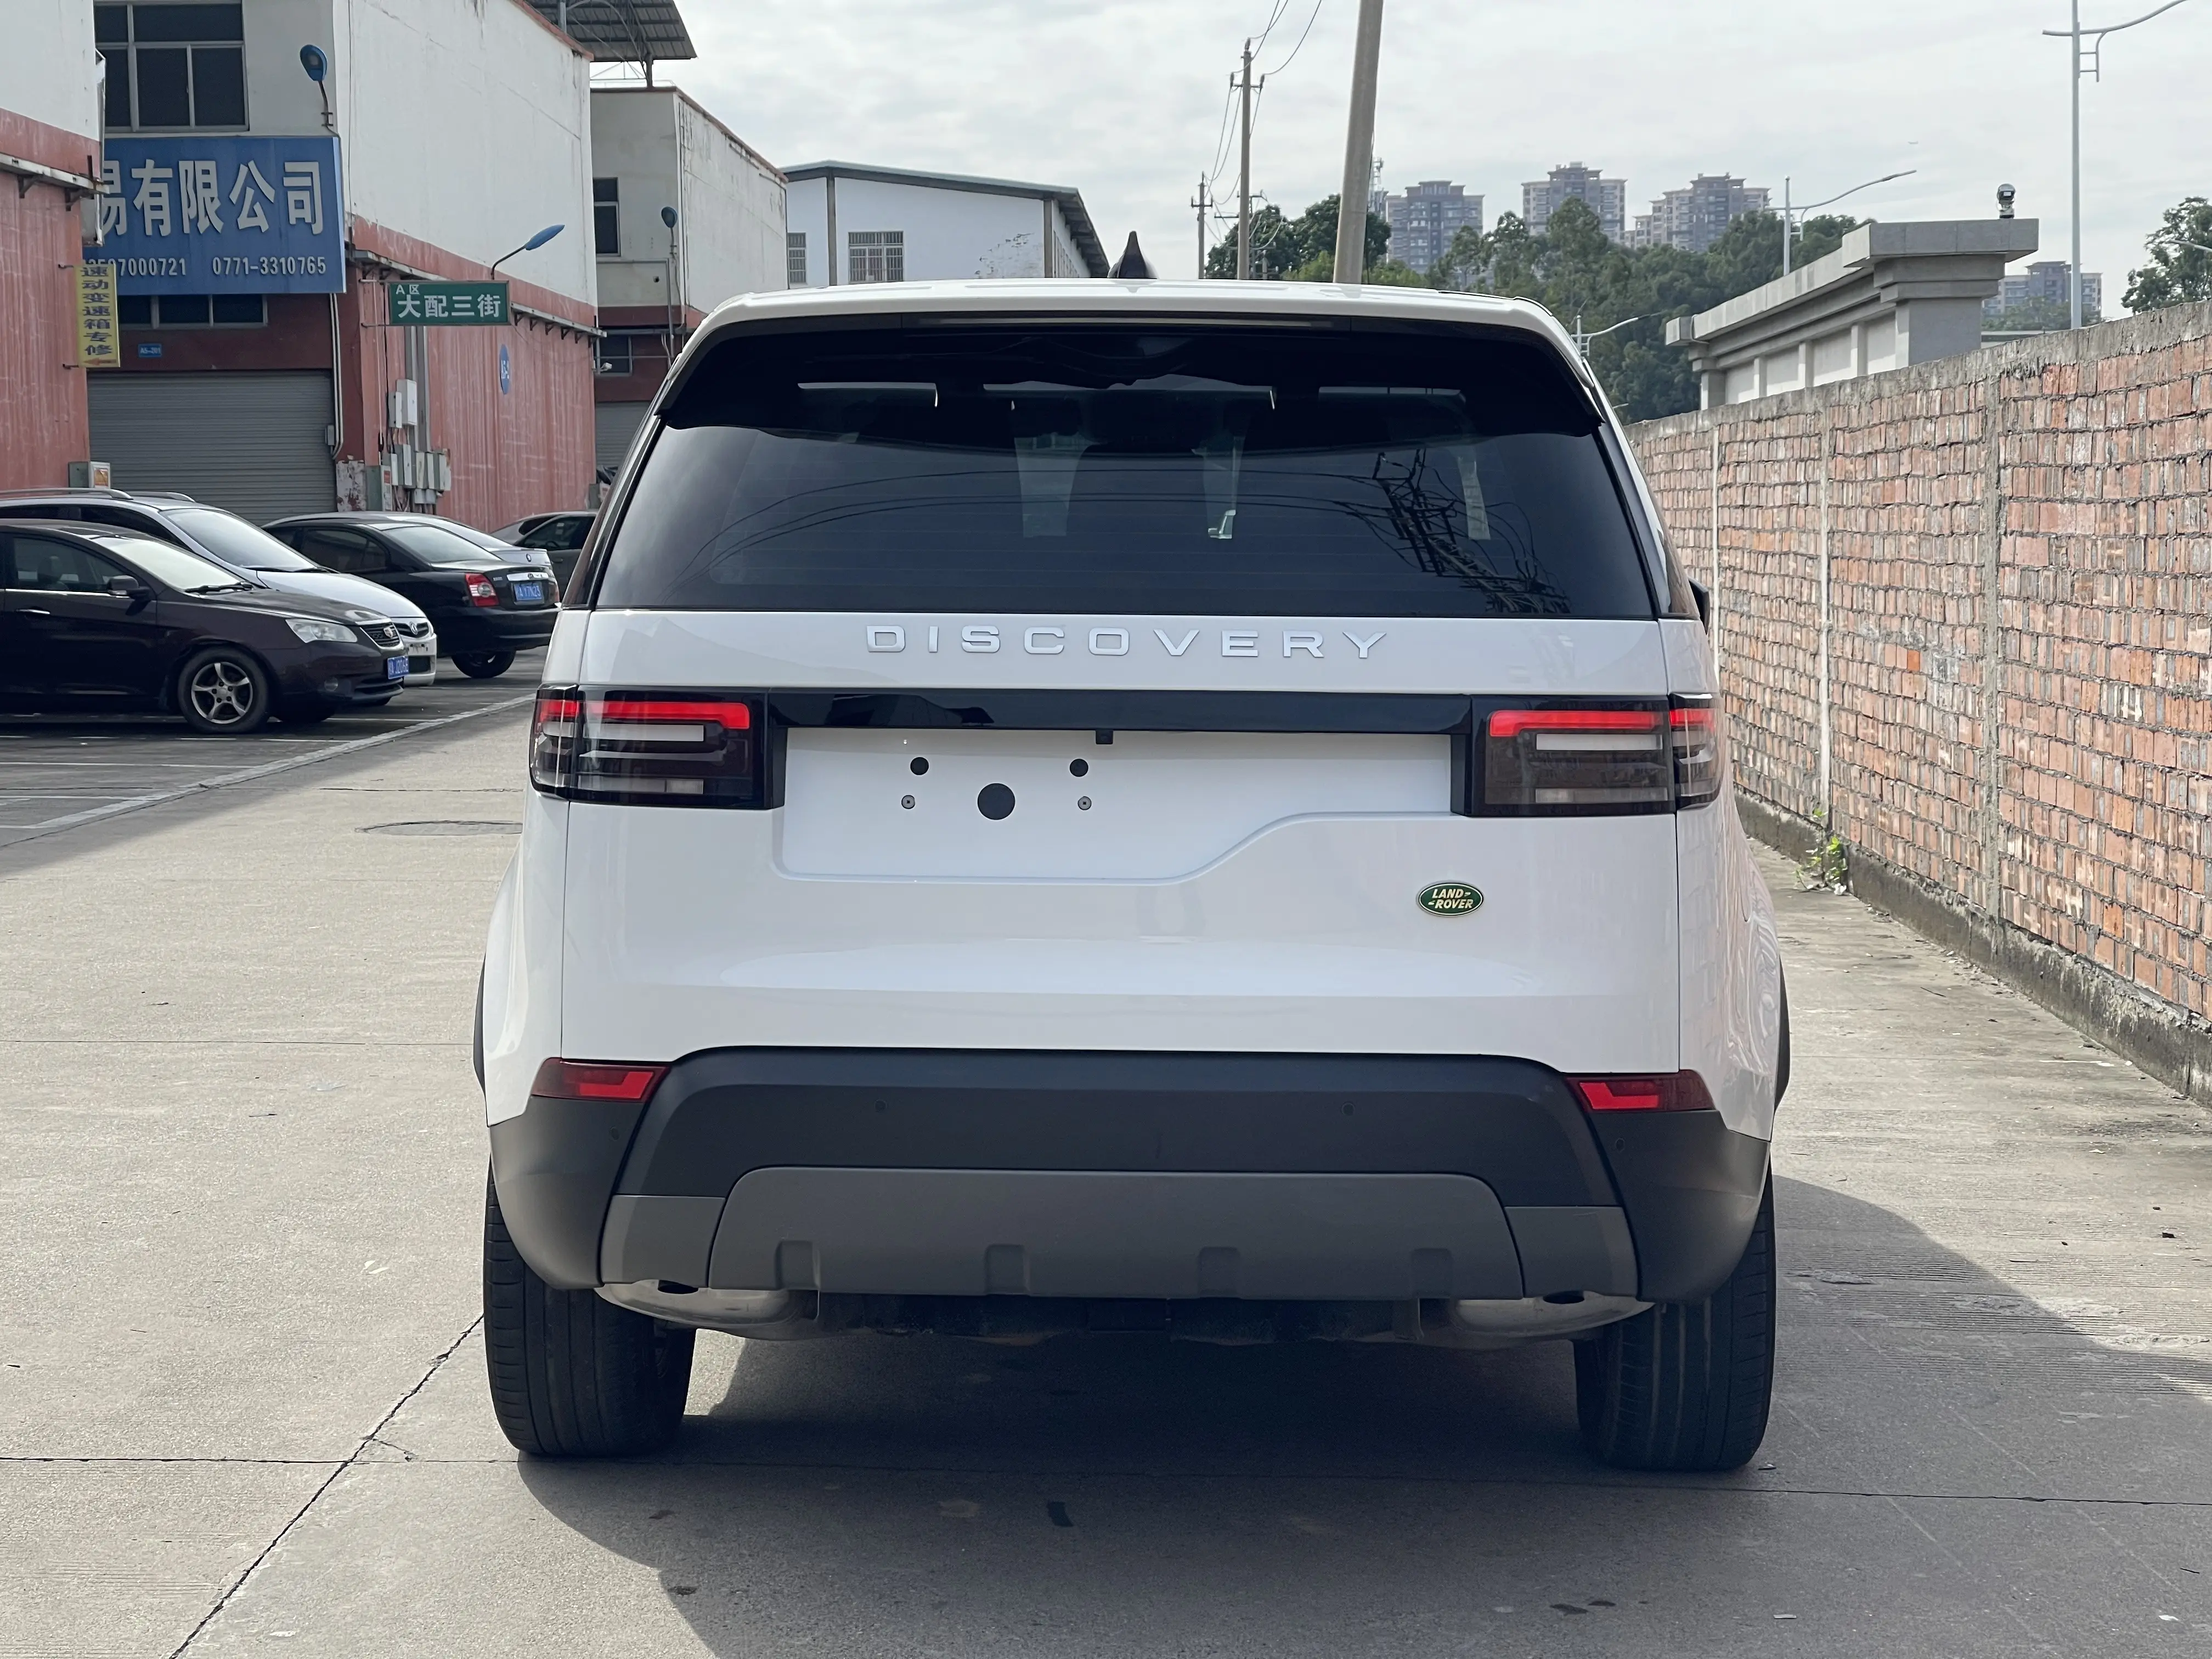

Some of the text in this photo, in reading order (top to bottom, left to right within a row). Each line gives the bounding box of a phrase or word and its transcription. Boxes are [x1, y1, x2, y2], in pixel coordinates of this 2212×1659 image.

[103, 159, 323, 236] 易有限公司
[212, 256, 326, 275] 0771-3310765
[397, 294, 501, 318] 大配三街
[866, 624, 1387, 659] DISCOVERY
